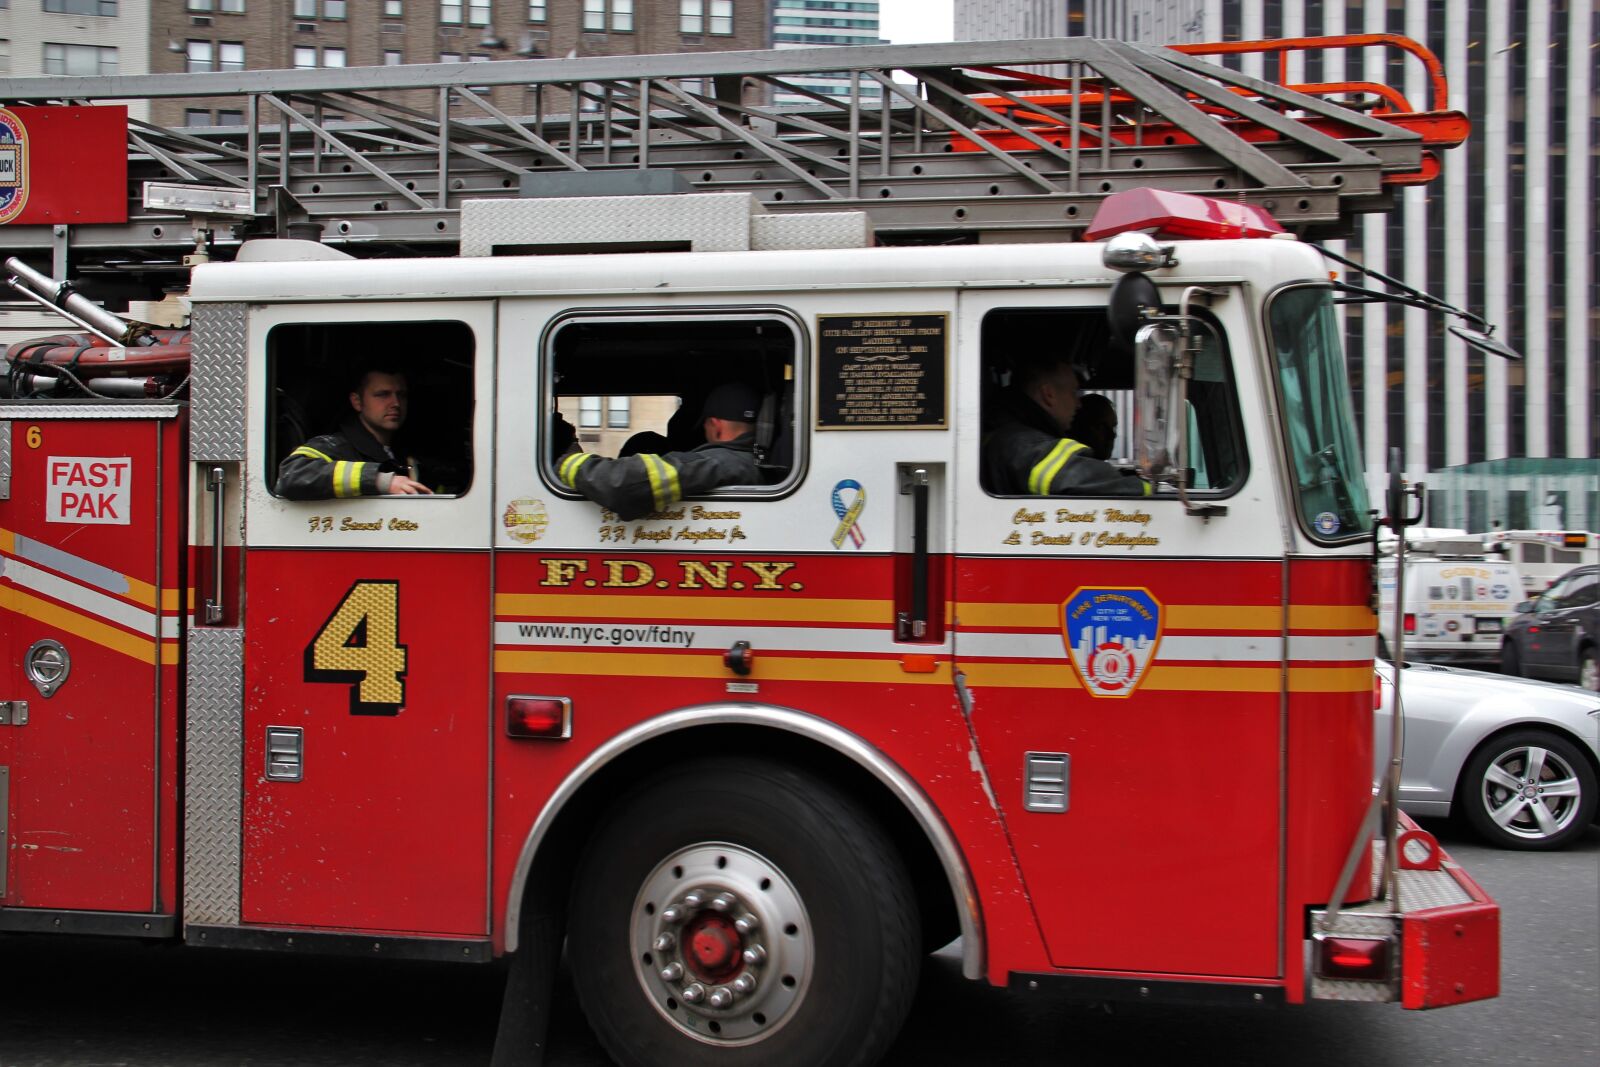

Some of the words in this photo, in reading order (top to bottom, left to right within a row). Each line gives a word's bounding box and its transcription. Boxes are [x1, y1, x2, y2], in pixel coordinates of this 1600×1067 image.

[0, 113, 22, 140] IDTOWN
[0, 159, 13, 172] UCK
[26, 425, 42, 449] 6
[52, 462, 128, 488] FAST
[60, 492, 119, 519] PAK
[539, 558, 804, 590] F.D.N.Y.
[1071, 601, 1093, 619] FIRE
[1093, 593, 1154, 620] DEPARTMENT
[303, 579, 408, 716] 4
[519, 624, 695, 647] www.nyc.gov/fdny
